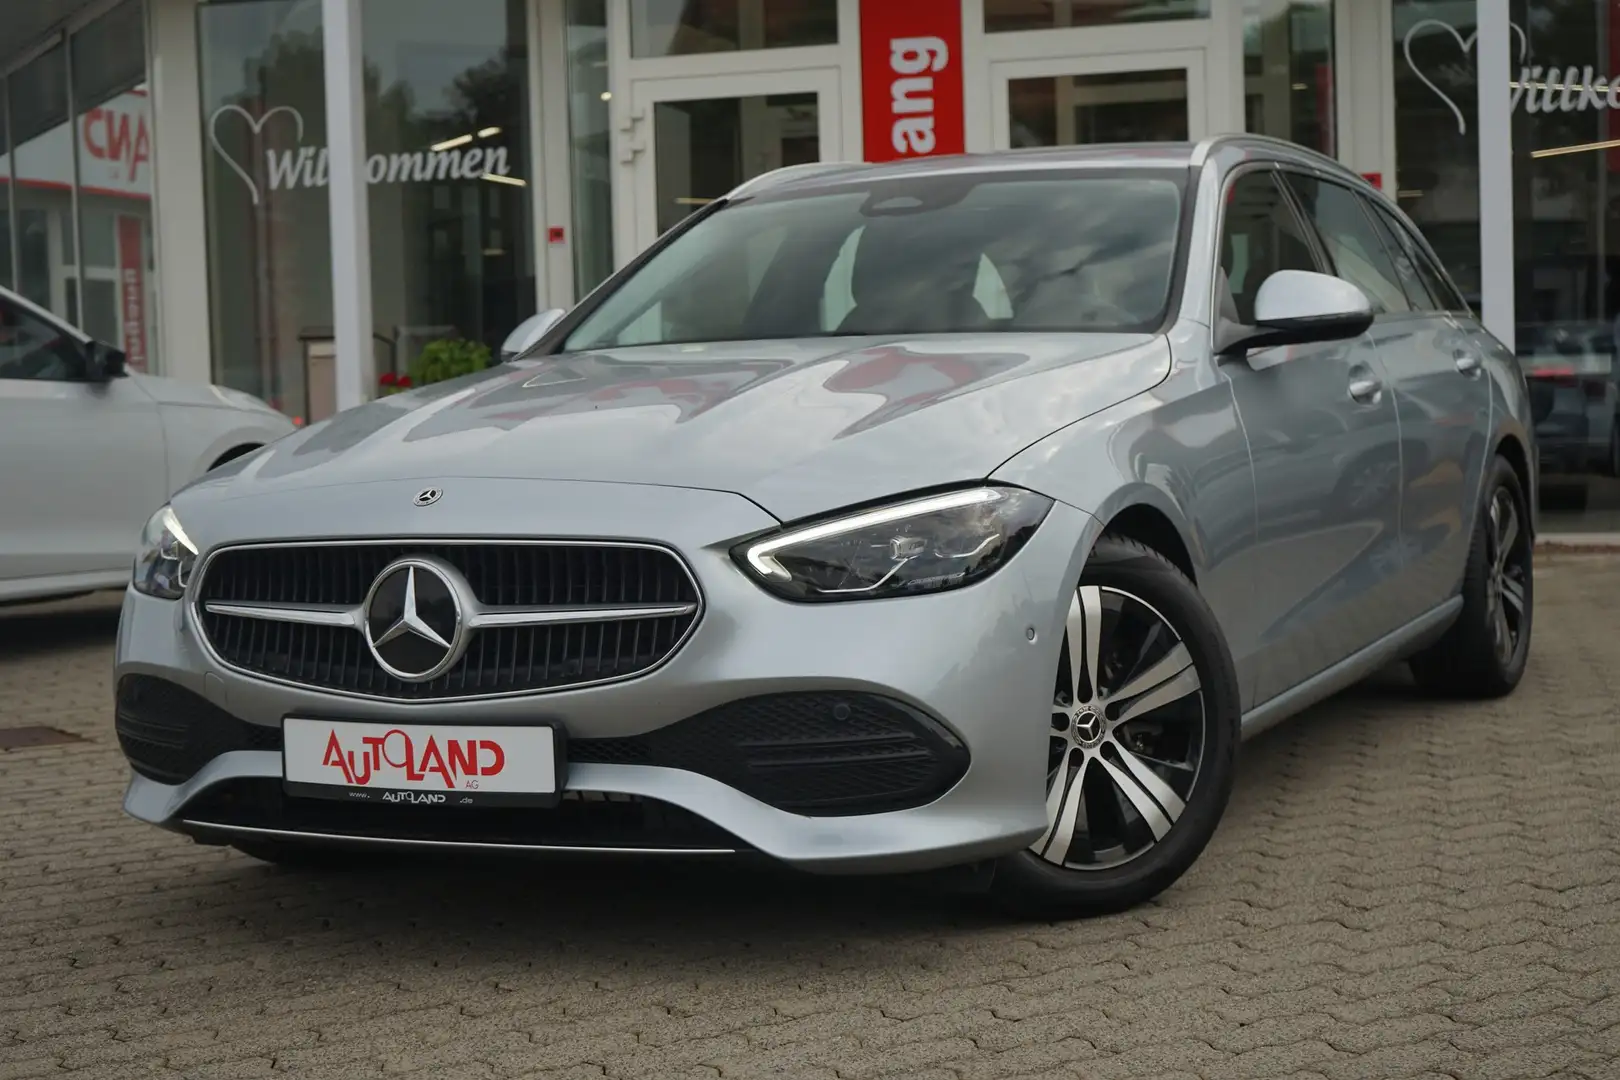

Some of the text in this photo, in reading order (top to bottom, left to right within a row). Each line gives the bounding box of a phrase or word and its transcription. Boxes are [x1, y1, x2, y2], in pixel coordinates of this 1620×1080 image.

[266, 145, 511, 190] Wilommen
[322, 729, 505, 788] AUTOLAND
[382, 791, 446, 804] AUTOLAND
[464, 779, 479, 790] AG
